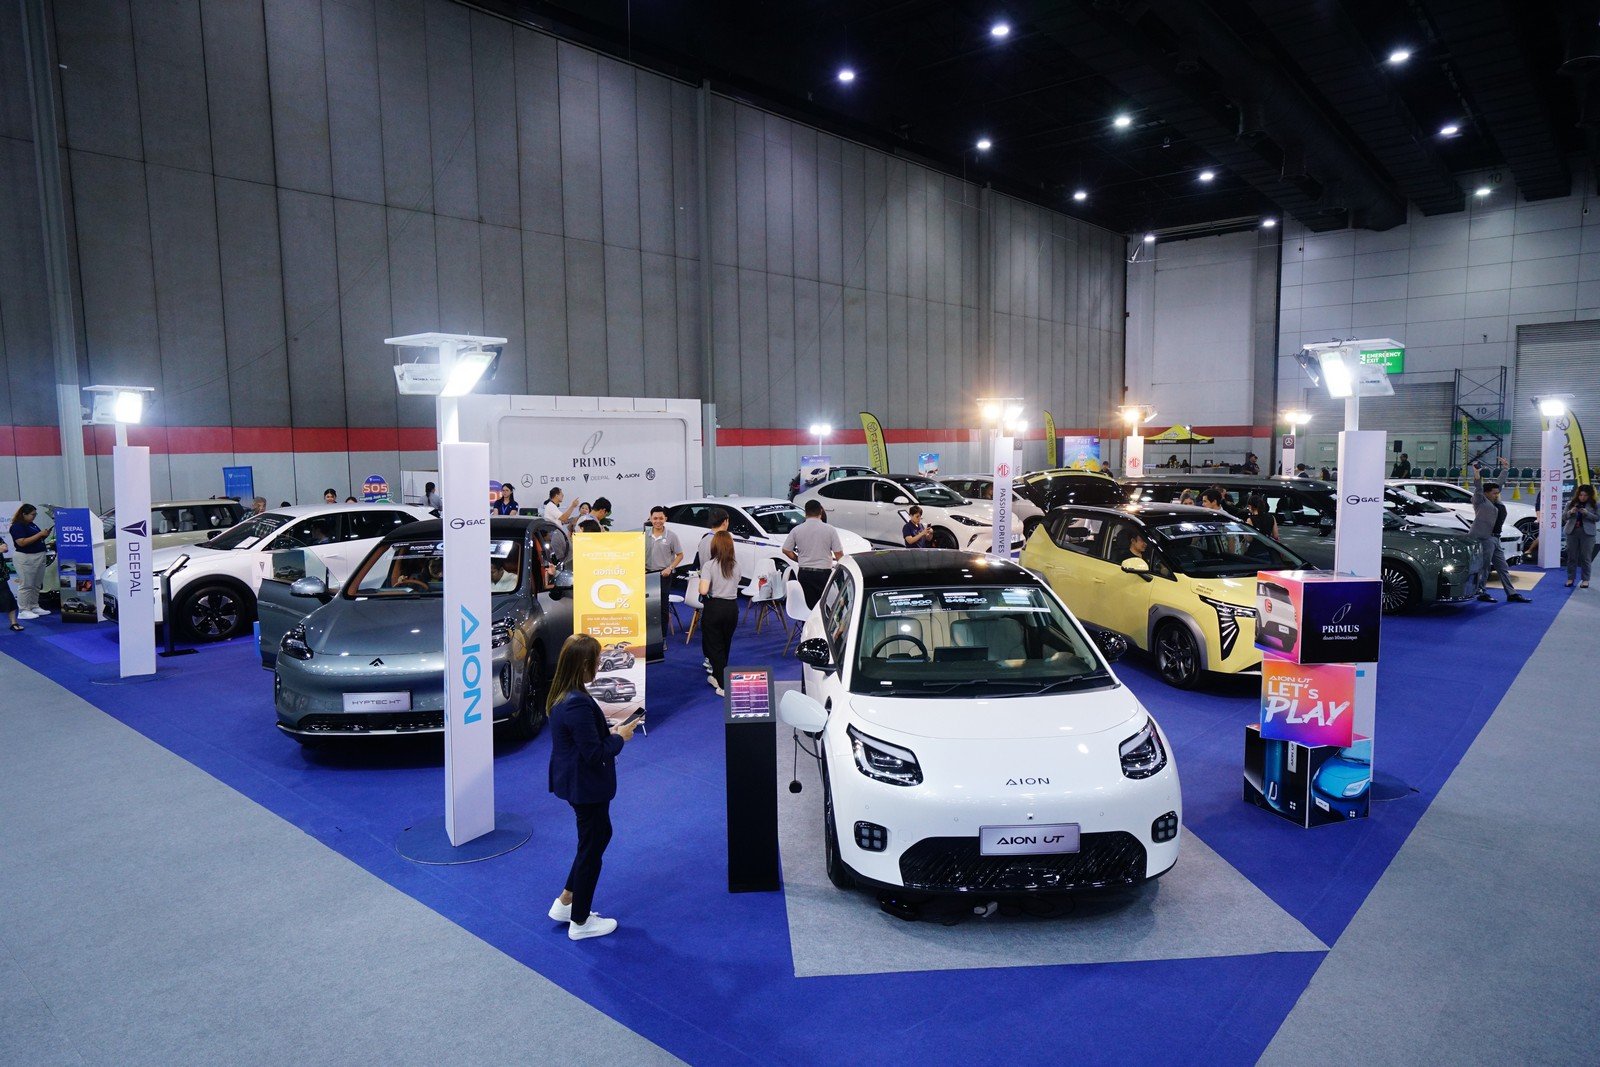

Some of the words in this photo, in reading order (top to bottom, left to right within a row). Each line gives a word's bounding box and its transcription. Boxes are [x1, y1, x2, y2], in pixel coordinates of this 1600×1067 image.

[1475, 407, 1487, 415] 10
[572, 457, 616, 468] PRIMUS
[998, 488, 1006, 523] PASSION
[1550, 486, 1558, 529] ZEEKR
[466, 518, 486, 526] GAC
[998, 525, 1006, 554] DRIVES
[128, 542, 141, 598] DEEPAL
[1322, 624, 1360, 633] PRIMUS
[460, 604, 482, 725] AION
[1264, 696, 1351, 727] PLAY
[1006, 777, 1050, 786] AION
[996, 836, 1037, 845] AION
[1043, 835, 1065, 844] UT
